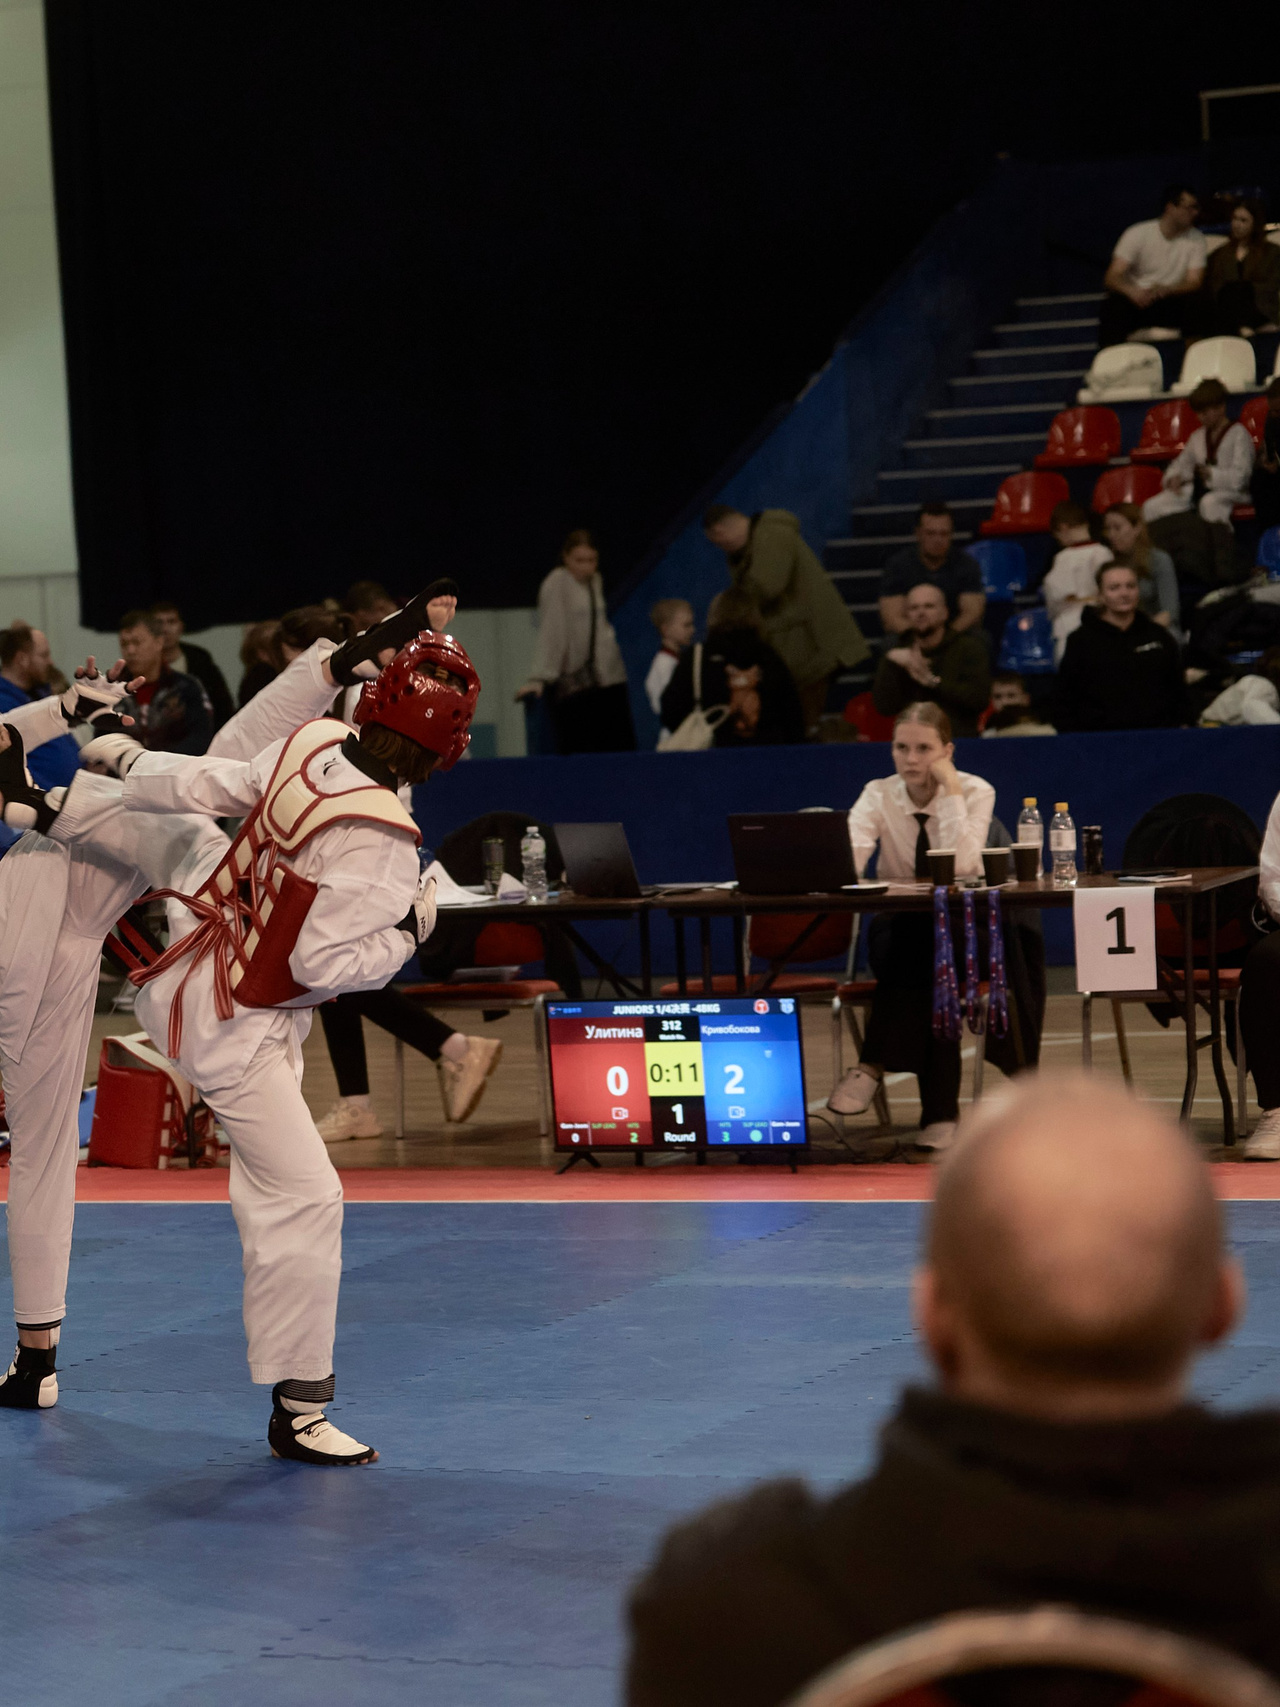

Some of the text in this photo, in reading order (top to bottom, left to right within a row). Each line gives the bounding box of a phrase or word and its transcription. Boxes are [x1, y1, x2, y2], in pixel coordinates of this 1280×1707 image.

[425, 708, 434, 718] S
[1106, 907, 1135, 954] 1
[612, 1005, 654, 1015] JUNIORS
[661, 1020, 682, 1031] 312
[701, 1024, 761, 1036] Кривобокова
[585, 1025, 643, 1039] Улитина
[650, 1063, 699, 1083] 0:11
[607, 1066, 629, 1096] 0
[723, 1064, 745, 1095] 2
[671, 1103, 684, 1125] 1
[571, 1132, 580, 1143] 0
[630, 1132, 639, 1143] 2
[664, 1131, 696, 1143] Round
[722, 1131, 730, 1142] 3
[782, 1131, 791, 1142] 0
